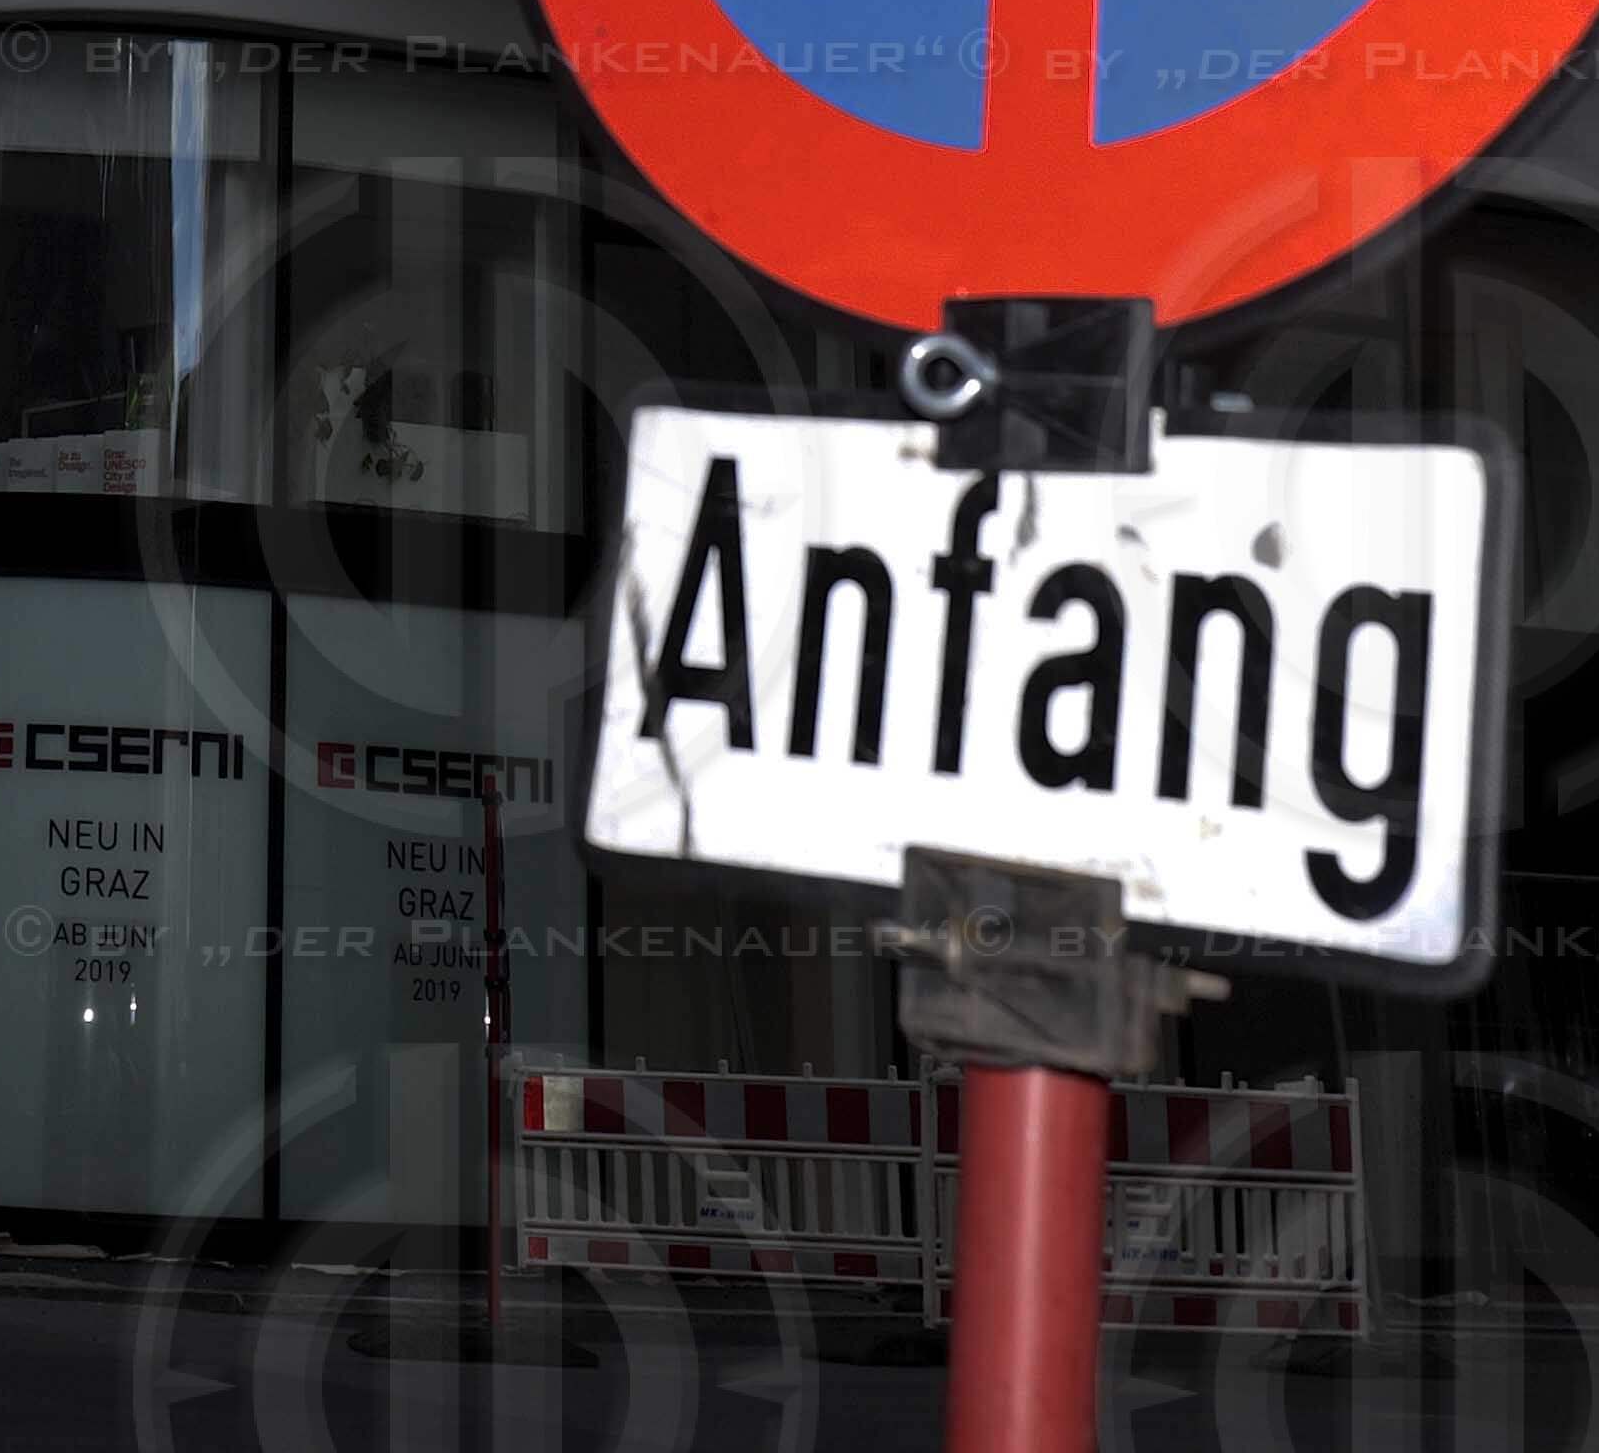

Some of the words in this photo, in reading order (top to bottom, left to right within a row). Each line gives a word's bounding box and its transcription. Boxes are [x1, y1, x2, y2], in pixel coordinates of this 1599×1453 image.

[105, 460, 146, 470] UNESCO
[638, 454, 1435, 922] Anfang
[49, 819, 118, 852] NEU
[132, 822, 165, 854] IN
[387, 841, 447, 873] NEU
[459, 844, 487, 876] IN
[60, 868, 151, 901] GRAZ
[398, 889, 475, 921] GRAZ
[53, 923, 89, 947] AB
[95, 924, 156, 950] JUNI
[74, 959, 132, 984] 2019
[394, 944, 422, 968] AB
[427, 945, 482, 971] JUNI
[413, 979, 461, 1003] 2019
